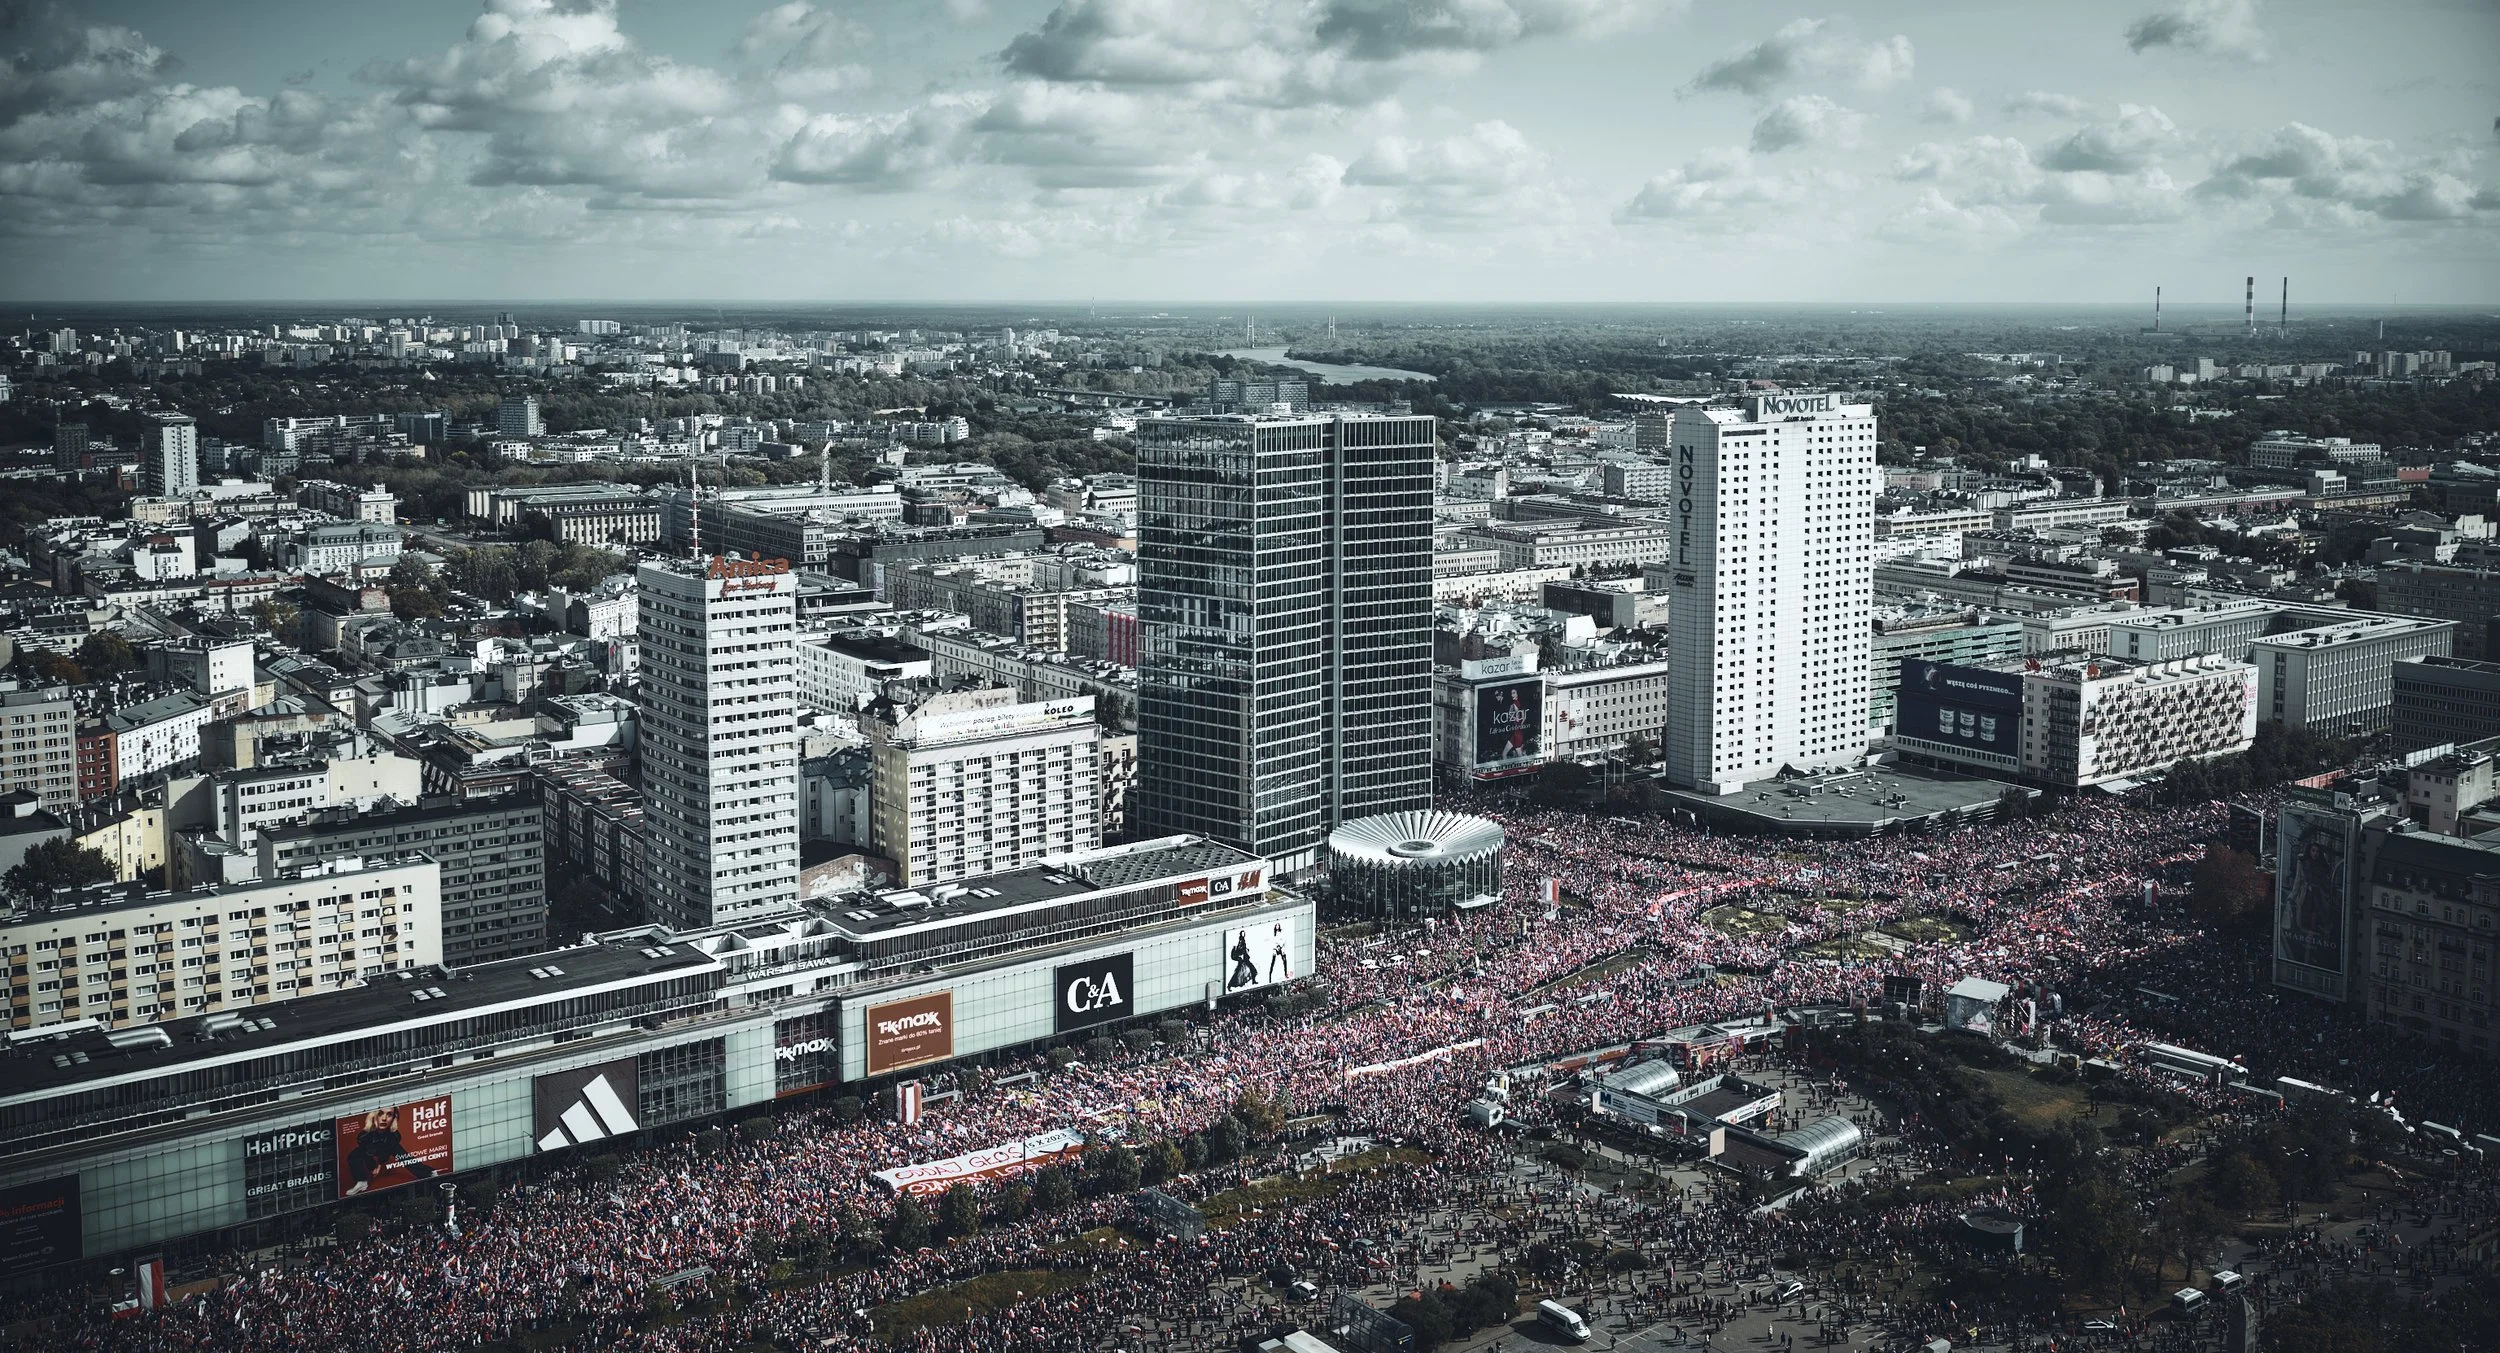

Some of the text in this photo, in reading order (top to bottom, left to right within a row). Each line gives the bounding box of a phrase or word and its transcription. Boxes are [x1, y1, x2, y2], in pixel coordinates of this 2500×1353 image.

[1763, 395, 1836, 415] NOVOTEL
[1679, 445, 1694, 565] NOVOTEL
[708, 551, 789, 580] Amica
[1481, 662, 1510, 675] kazar
[1044, 704, 1074, 716] KOLEO
[1493, 708, 1530, 725] kazar
[747, 958, 831, 980] WARS SAWA
[1067, 971, 1124, 1013] C&A
[1600, 1091, 1612, 1105] M
[413, 1100, 447, 1121] Half
[413, 1118, 448, 1134] Price
[246, 1129, 332, 1157] HalfPrice
[1045, 1132, 1067, 1143] 2023
[395, 1144, 448, 1161] ŚWIATOWE MARKI
[385, 1156, 428, 1170] WYJĄTKOWE
[895, 1146, 1024, 1180] ODDAJ GŁOS
[247, 1170, 333, 1197] GREAT BRANDS
